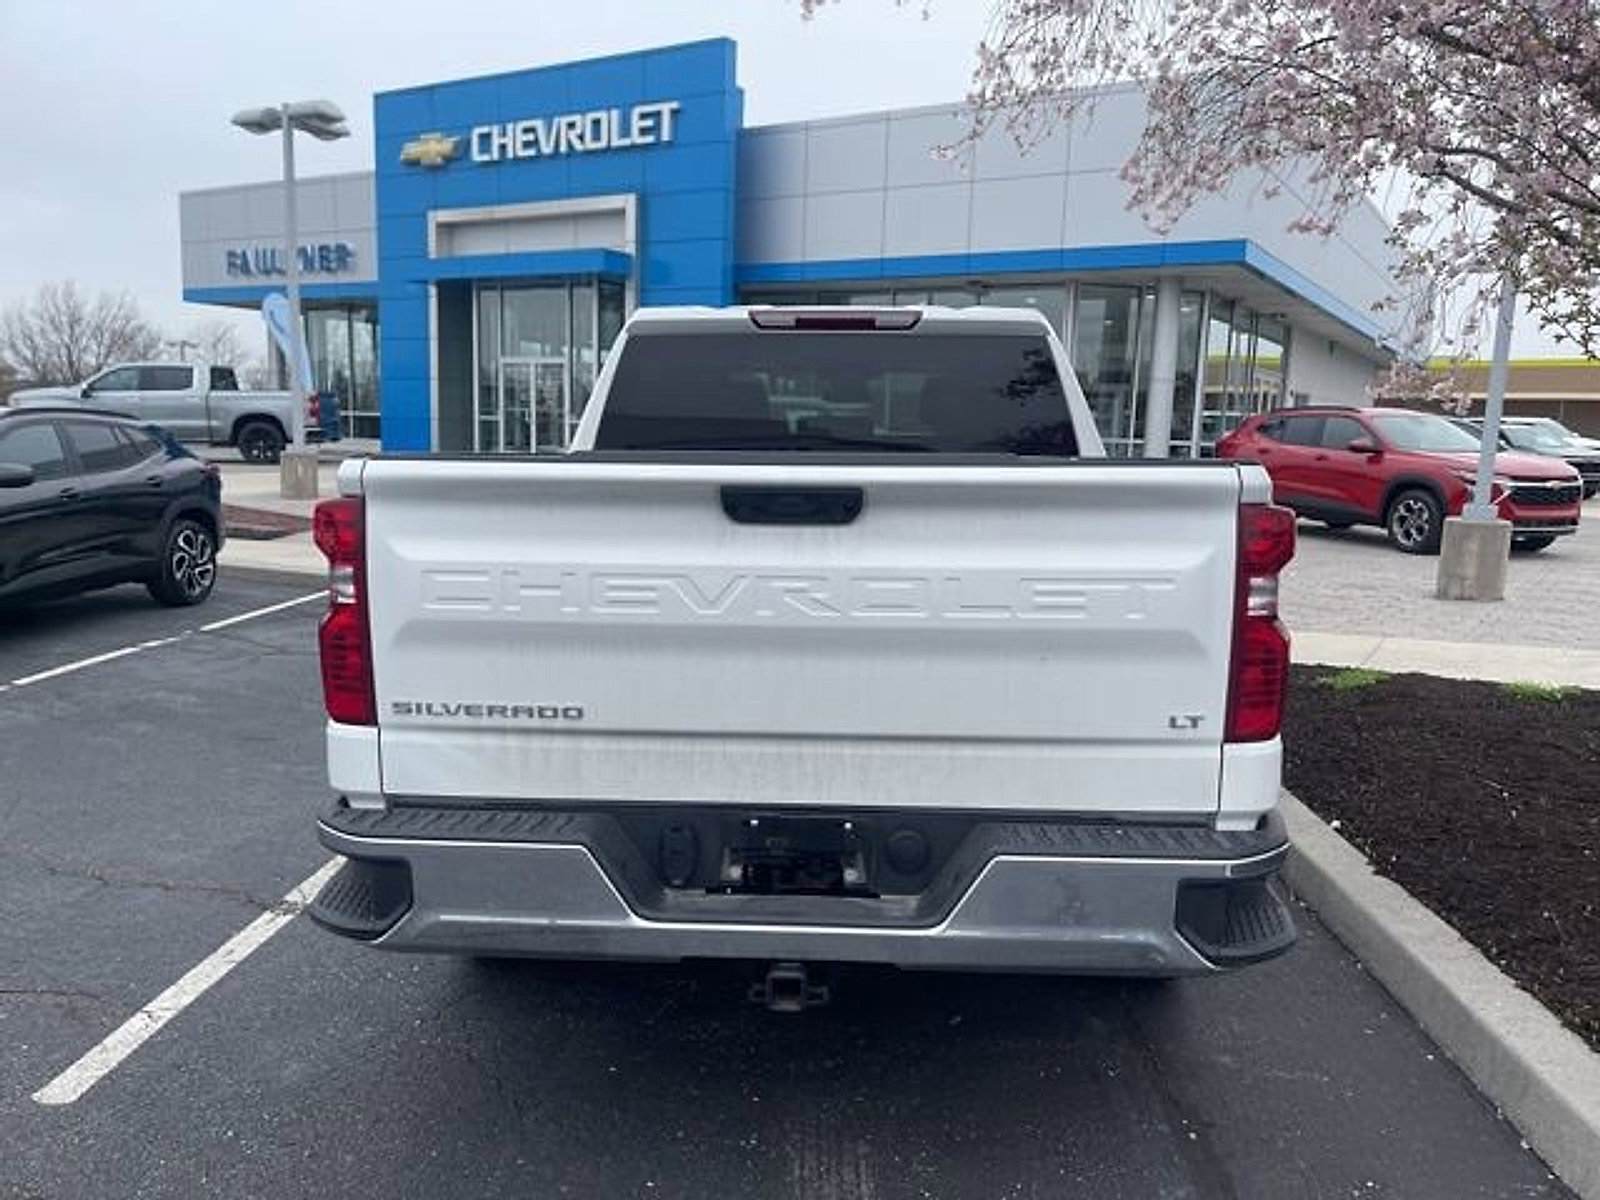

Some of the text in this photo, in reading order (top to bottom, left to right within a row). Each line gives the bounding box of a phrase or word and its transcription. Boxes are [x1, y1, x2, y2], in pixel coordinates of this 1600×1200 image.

[470, 101, 680, 162] CHEVROLET
[226, 242, 355, 277] FAULNER
[420, 569, 1177, 619] CHEVROLET
[391, 702, 584, 719] SILVERADO
[1168, 714, 1206, 729] LT
